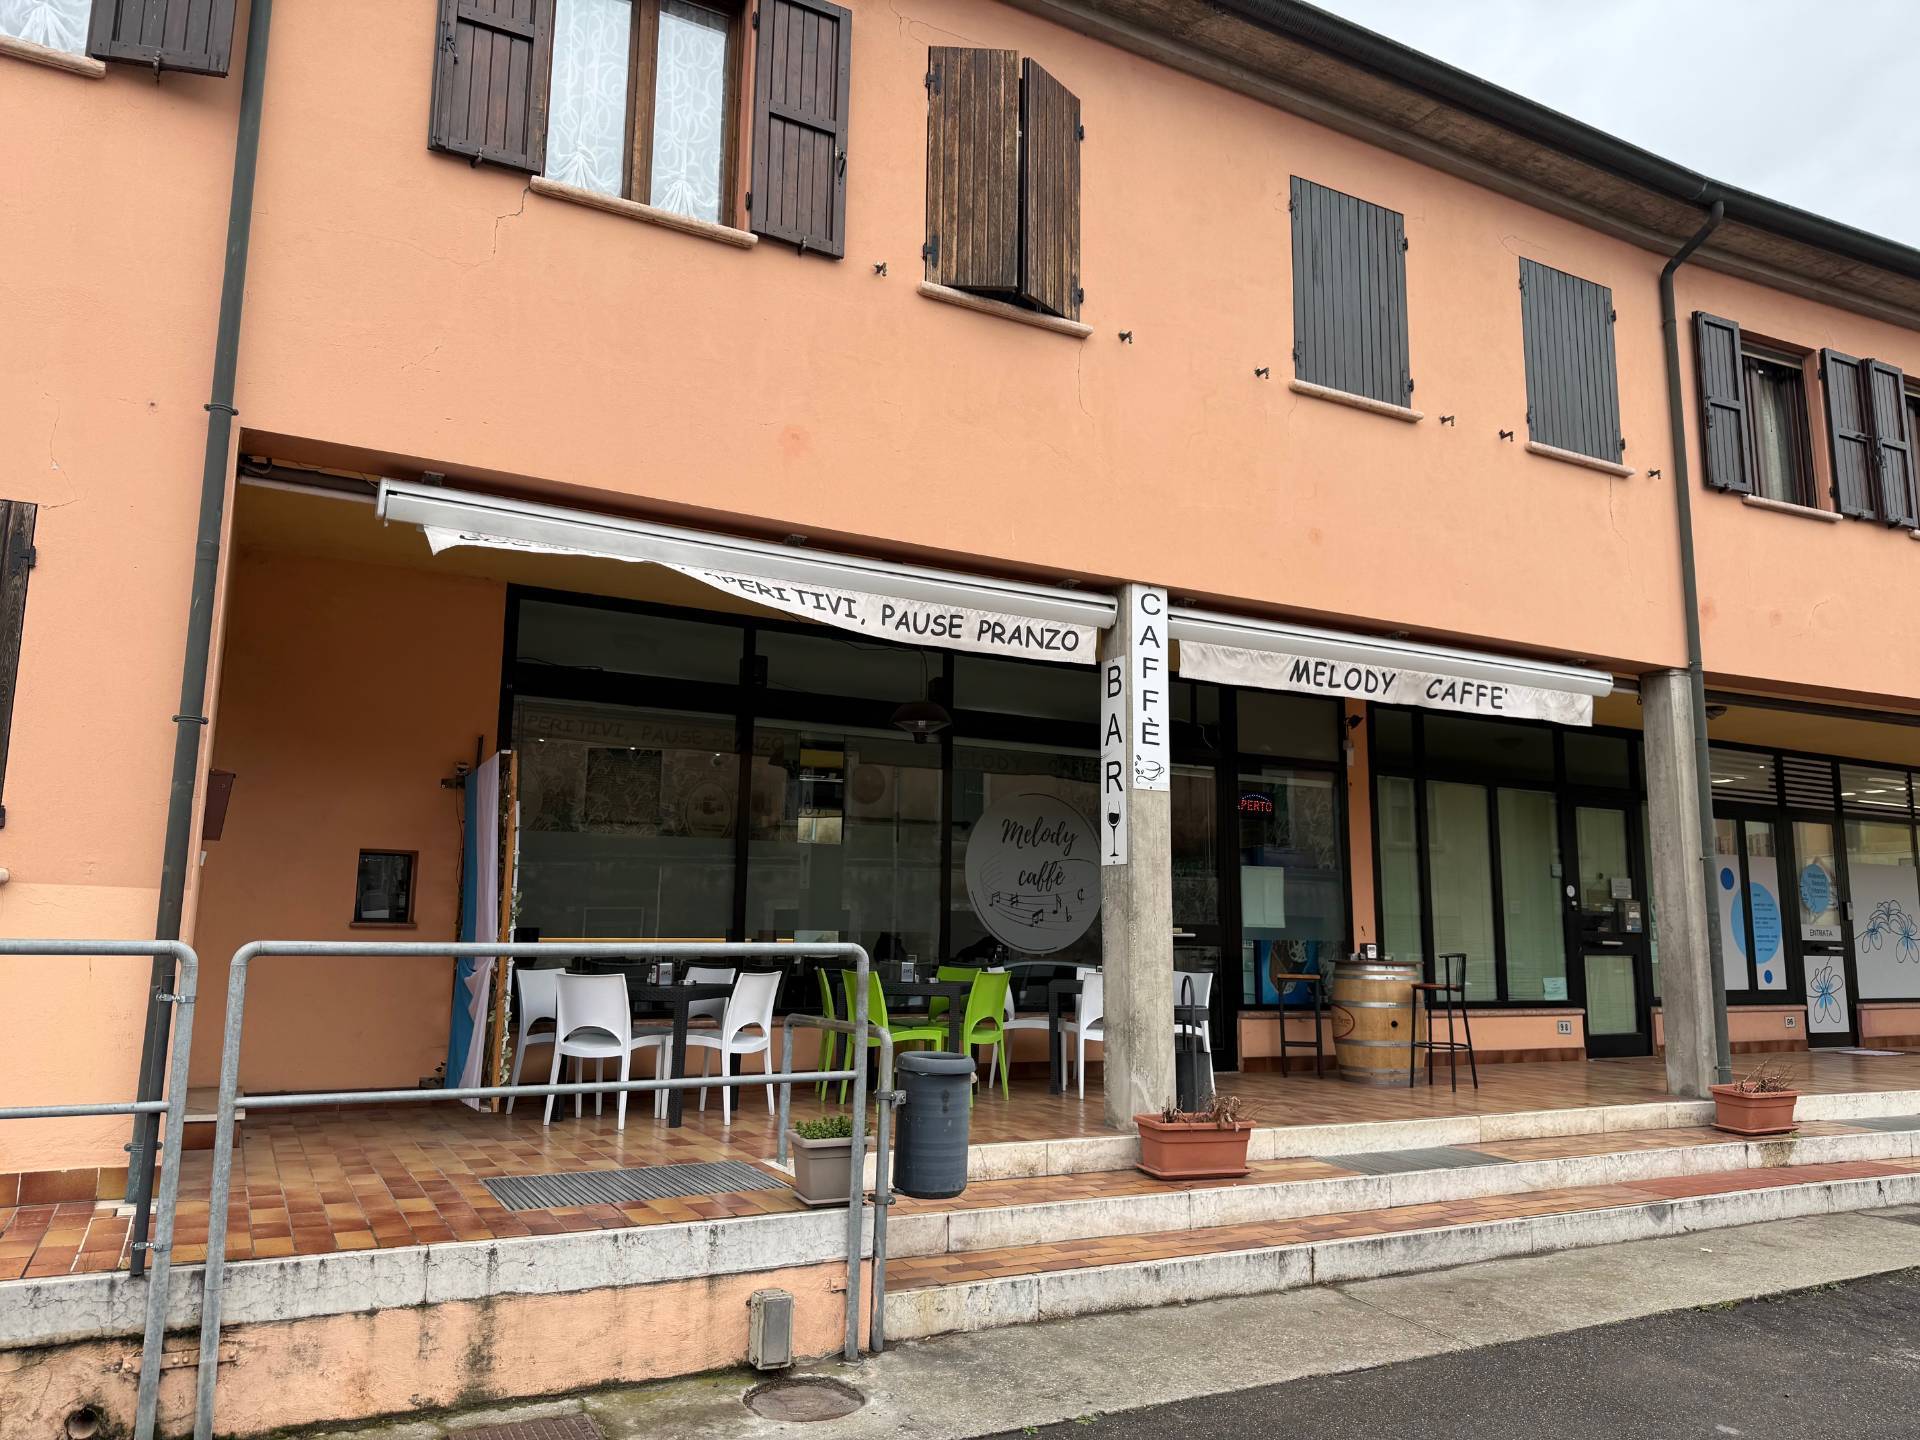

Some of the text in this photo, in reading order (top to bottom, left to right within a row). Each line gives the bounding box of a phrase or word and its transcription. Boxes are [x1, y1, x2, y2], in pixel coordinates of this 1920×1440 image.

[881, 603, 964, 639] PAUSE
[976, 619, 1080, 652] PRANZO
[1139, 592, 1161, 746] CAFFÈ
[1289, 659, 1508, 710] MELODY CAFFE'
[1104, 665, 1124, 795] BAR
[1001, 815, 1080, 857] Melody
[1018, 860, 1066, 893] caffè
[1809, 928, 1833, 937] ENTRATA
